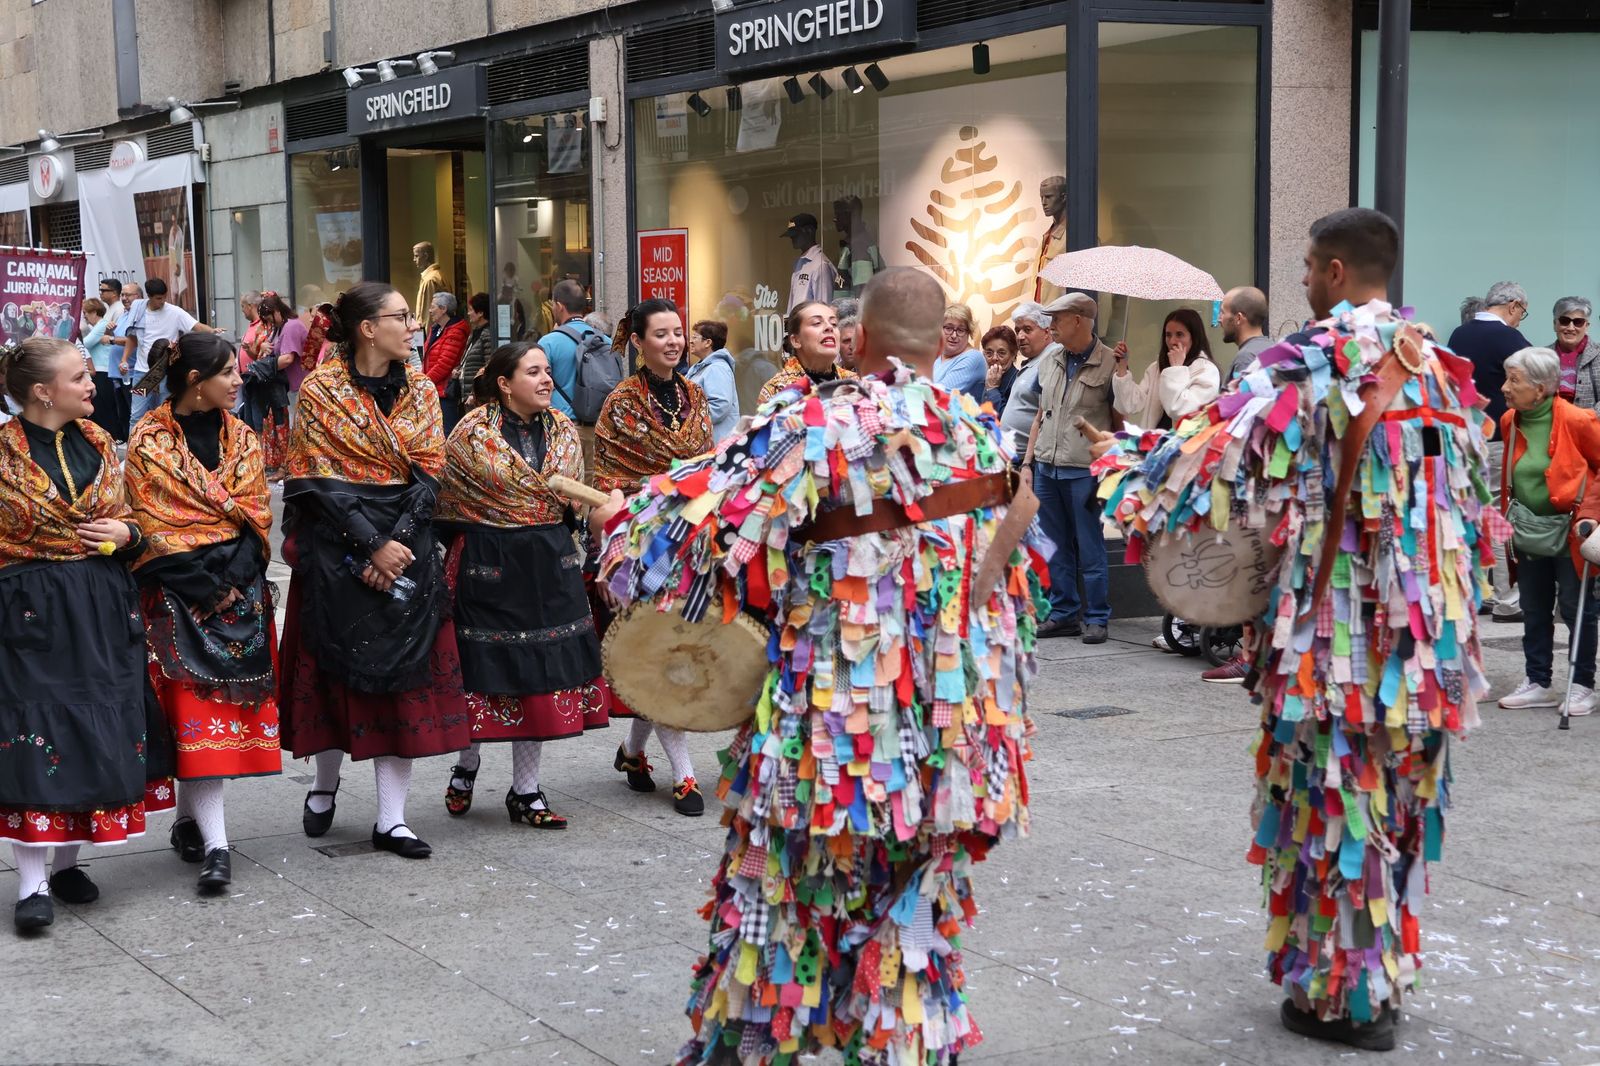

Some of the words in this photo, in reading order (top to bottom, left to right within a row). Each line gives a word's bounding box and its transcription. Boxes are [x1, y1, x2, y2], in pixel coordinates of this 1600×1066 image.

[729, 0, 884, 56] SPRINGFIELD
[366, 83, 452, 122] SPRINGFIELD
[653, 246, 673, 263] MID
[7, 261, 78, 281] CARNAVAL
[643, 266, 683, 283] SEASON
[3, 281, 77, 297] JURRAMACHO
[754, 283, 778, 310] The
[754, 313, 788, 352] NO
